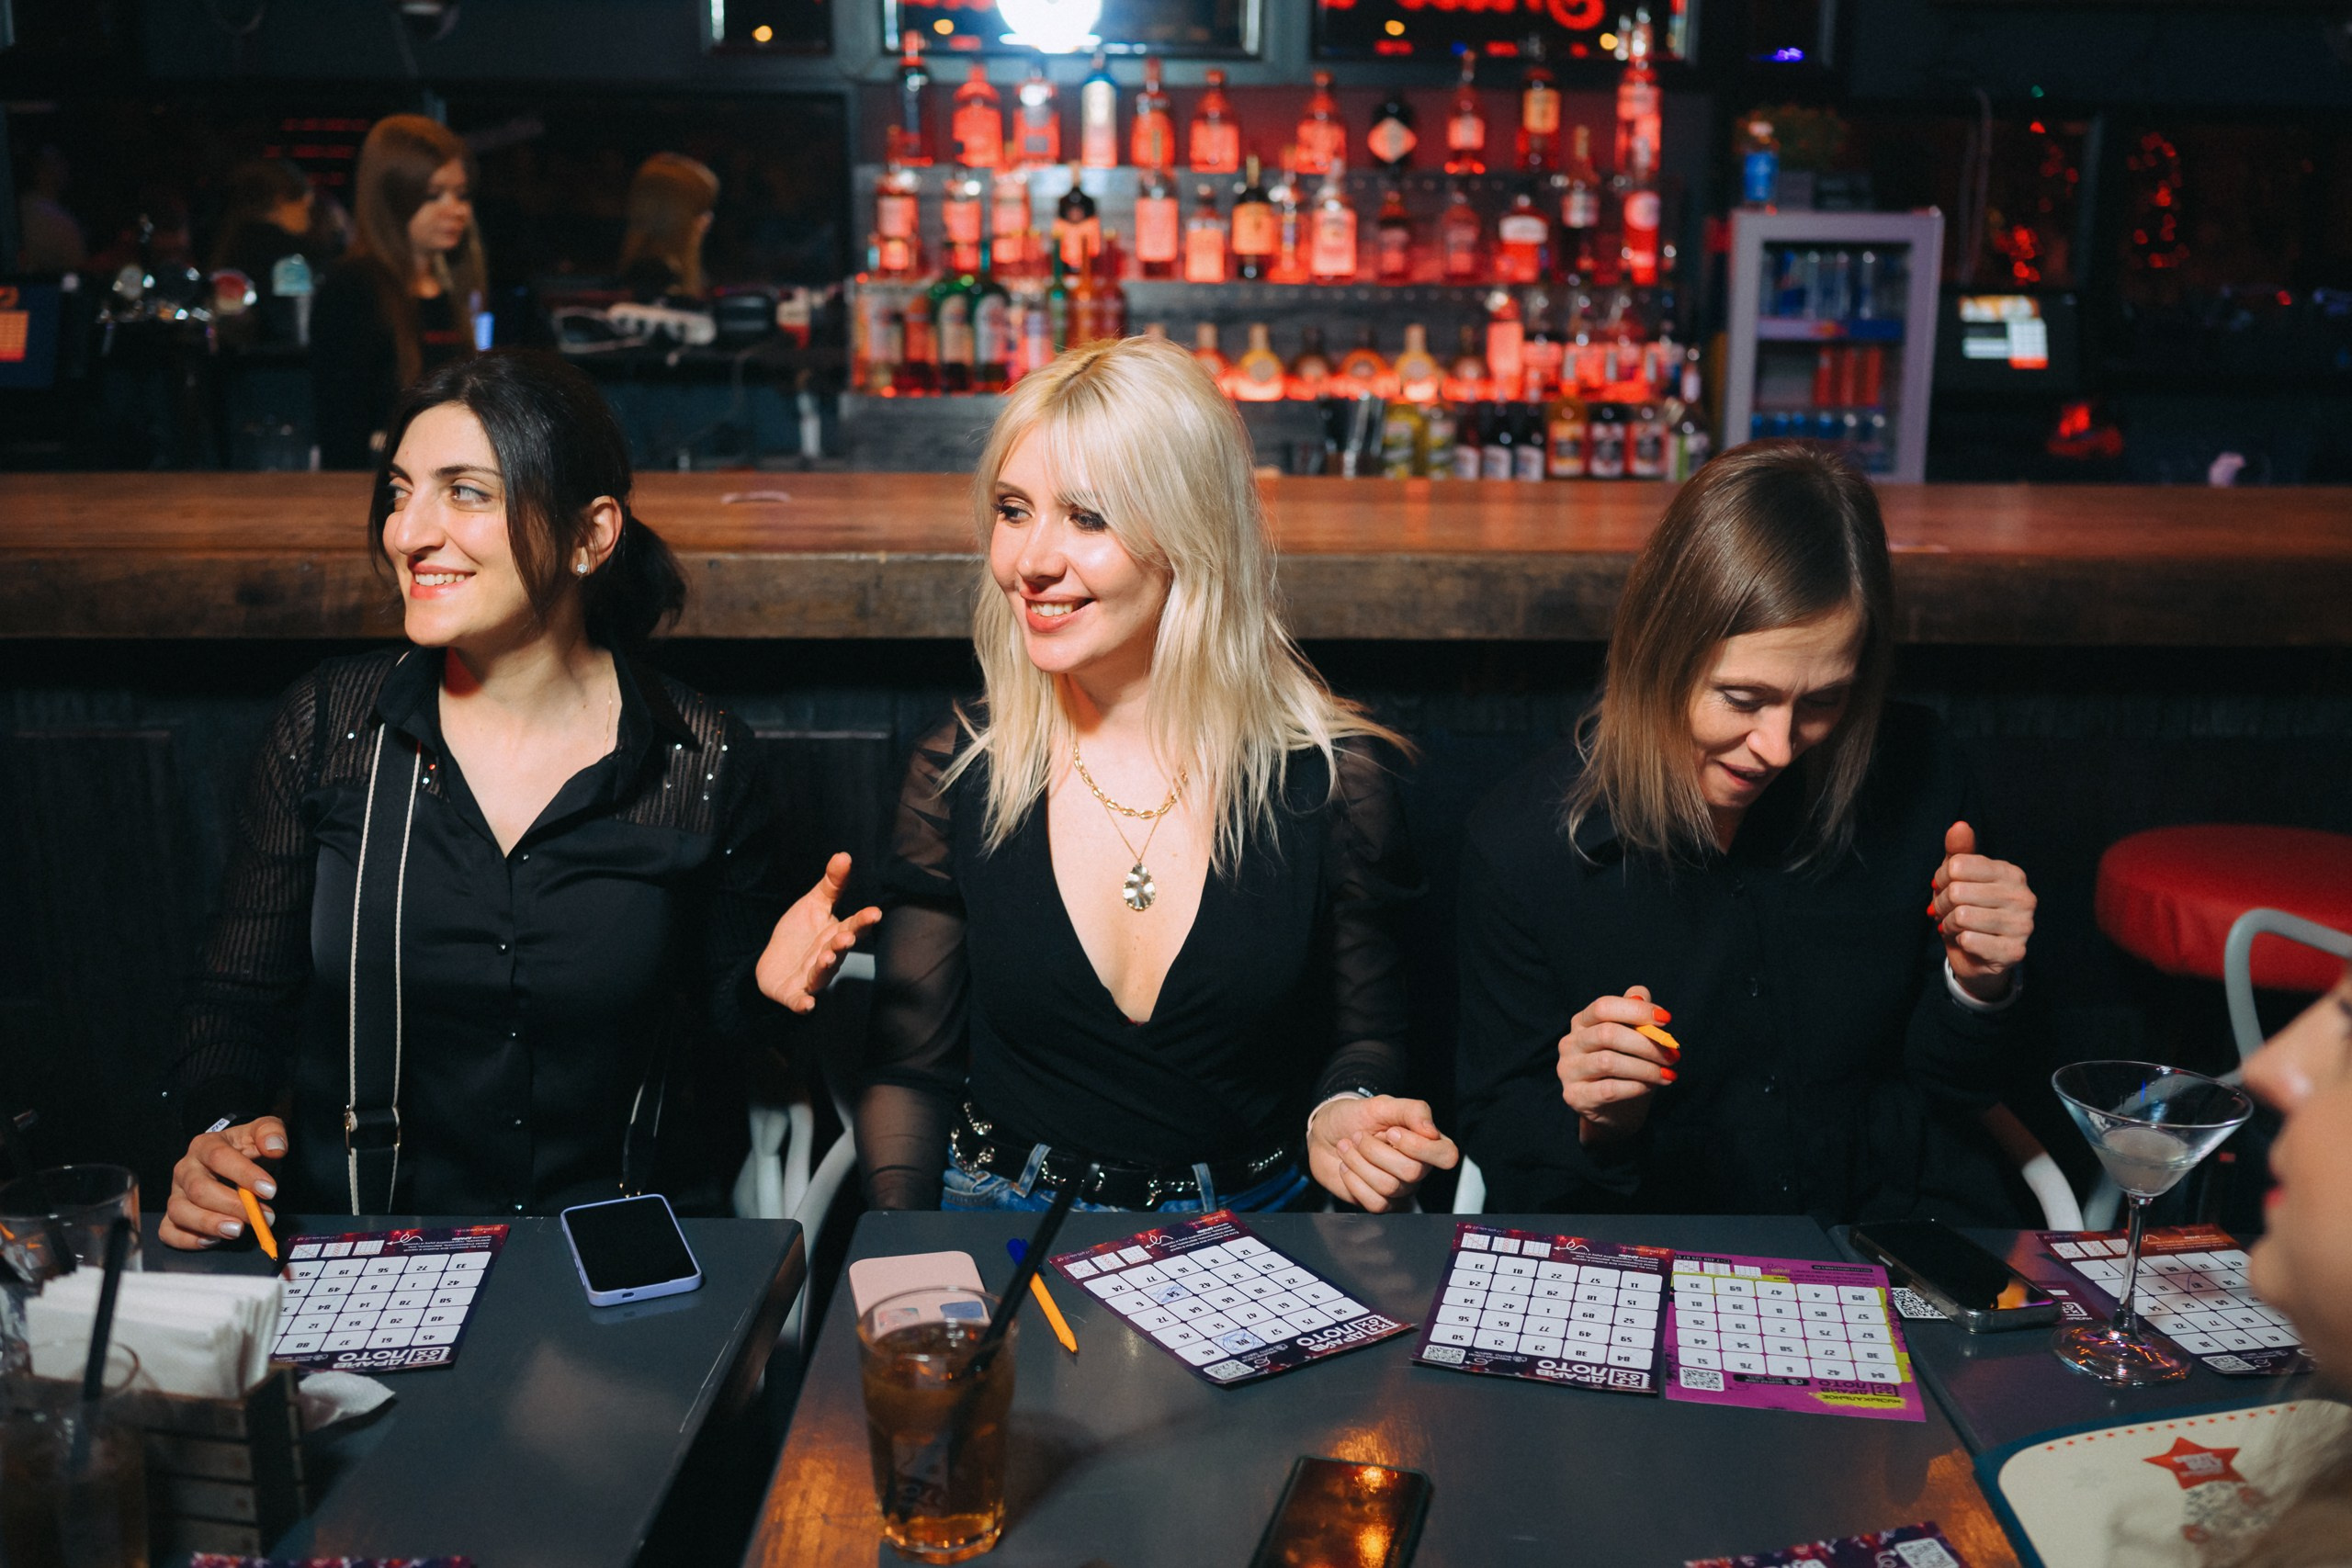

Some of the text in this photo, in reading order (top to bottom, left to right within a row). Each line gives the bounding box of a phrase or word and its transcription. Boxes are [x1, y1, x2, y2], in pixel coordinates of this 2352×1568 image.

[1112, 1284, 1125, 1292] 24
[1221, 1296, 1236, 1304] 66
[1178, 1332, 1193, 1340] 26
[1295, 1324, 1354, 1348] ЛОТО
[1308, 1331, 1366, 1352] ДРАЙВ
[338, 1348, 410, 1362] ЛОТО
[333, 1358, 404, 1369] ДРАЙВ
[1538, 1359, 1608, 1376] ЛОТО
[1535, 1369, 1607, 1384] ДРАЙВ
[1818, 1380, 1868, 1389] ЛОТО
[1820, 1387, 1869, 1396] ДРАЙВ
